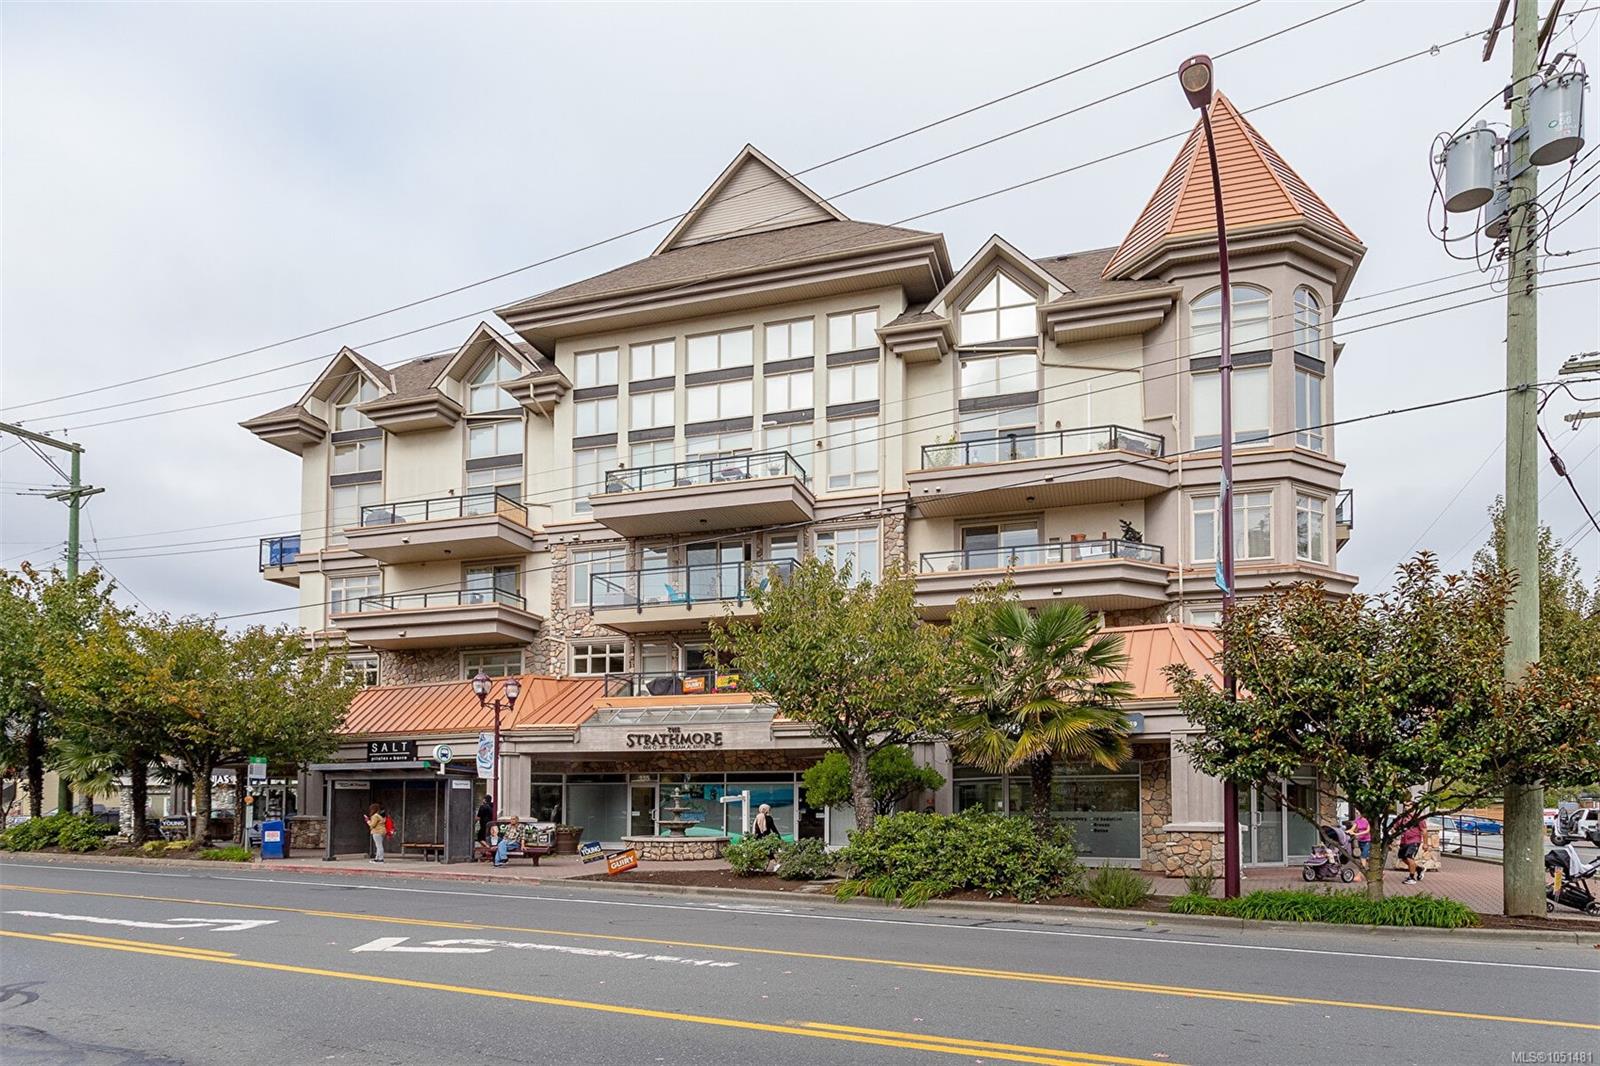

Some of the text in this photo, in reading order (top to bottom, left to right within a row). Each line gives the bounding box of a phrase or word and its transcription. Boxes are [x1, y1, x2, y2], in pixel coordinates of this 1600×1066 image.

[371, 741, 408, 753] SALT
[626, 732, 723, 748] STRATHMORE
[610, 855, 634, 869] GUIRY
